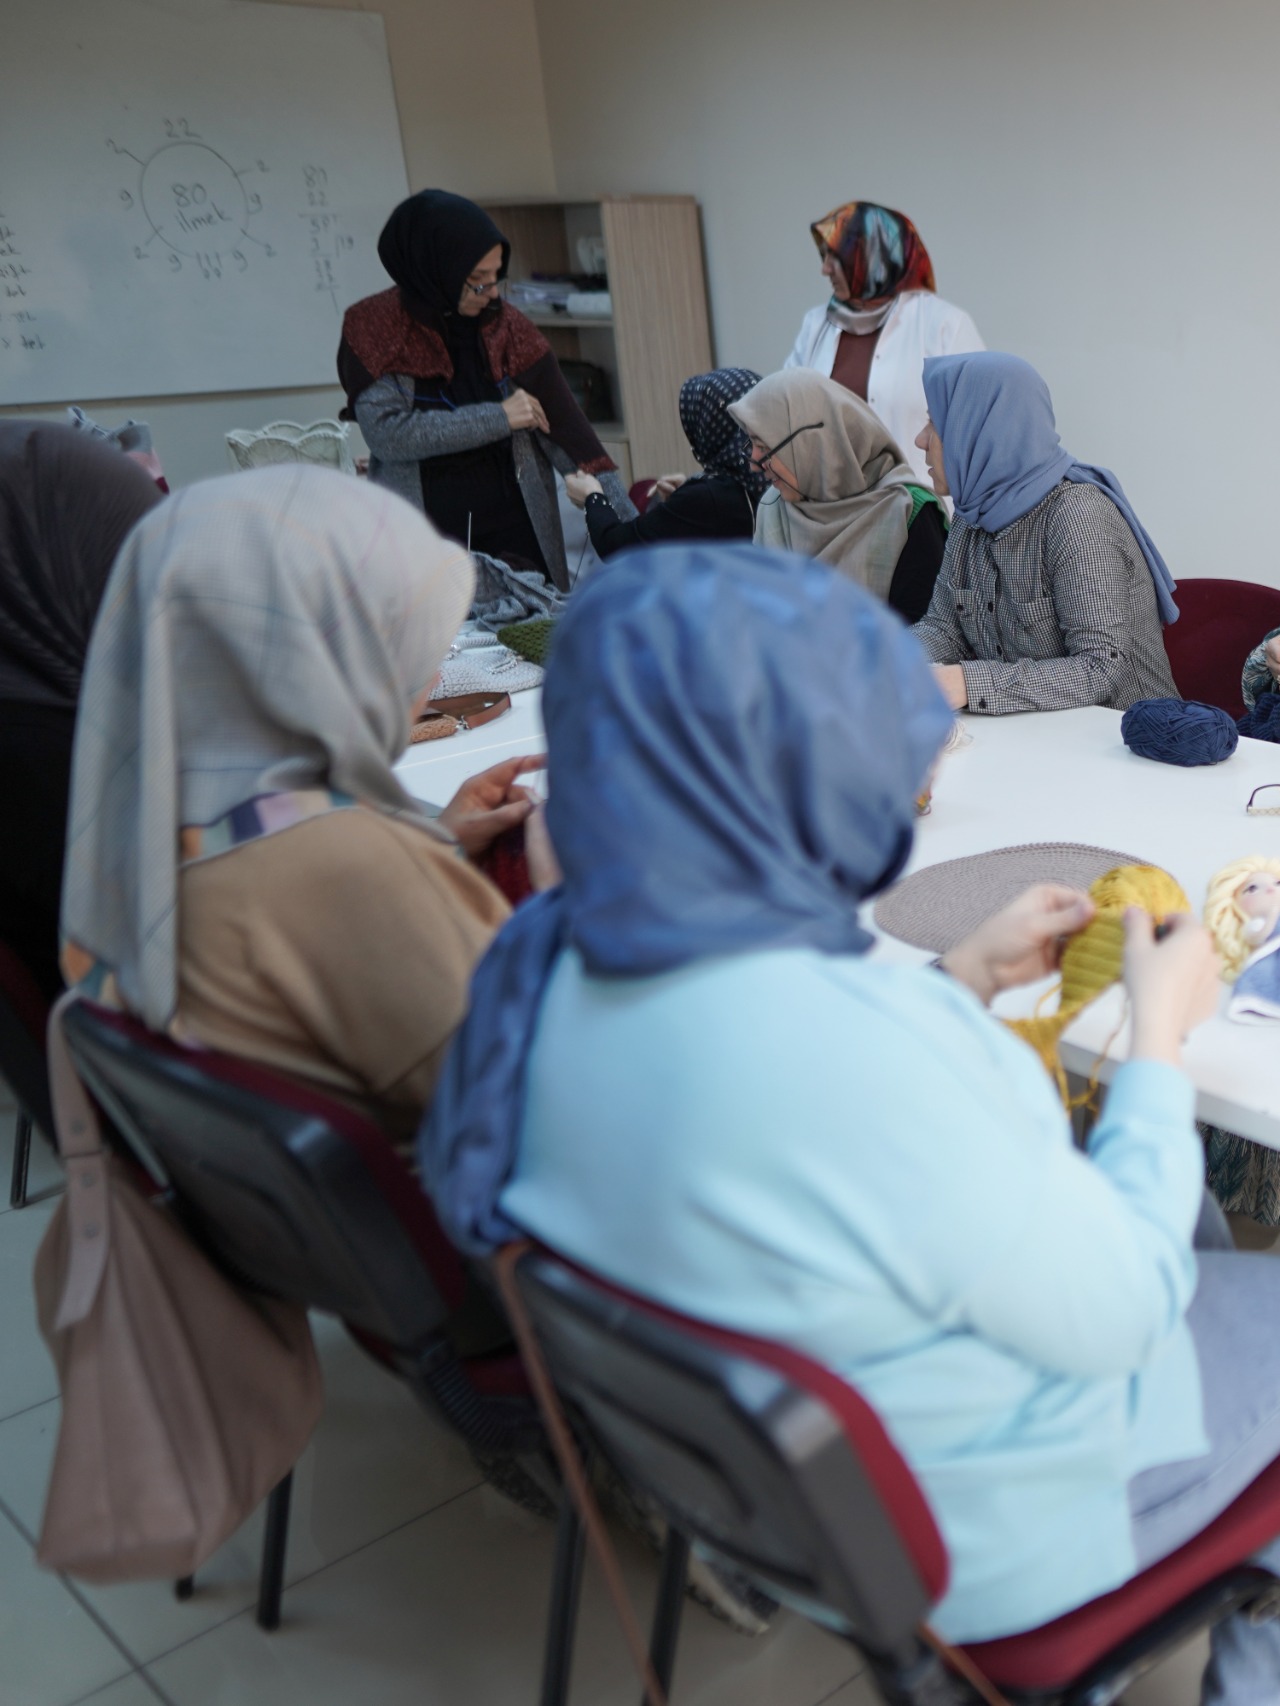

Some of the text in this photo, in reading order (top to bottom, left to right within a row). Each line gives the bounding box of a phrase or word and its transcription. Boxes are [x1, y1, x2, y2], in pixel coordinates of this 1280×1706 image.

[163, 117, 203, 140] 22
[171, 182, 208, 209] 80
[174, 201, 234, 234] ilmek
